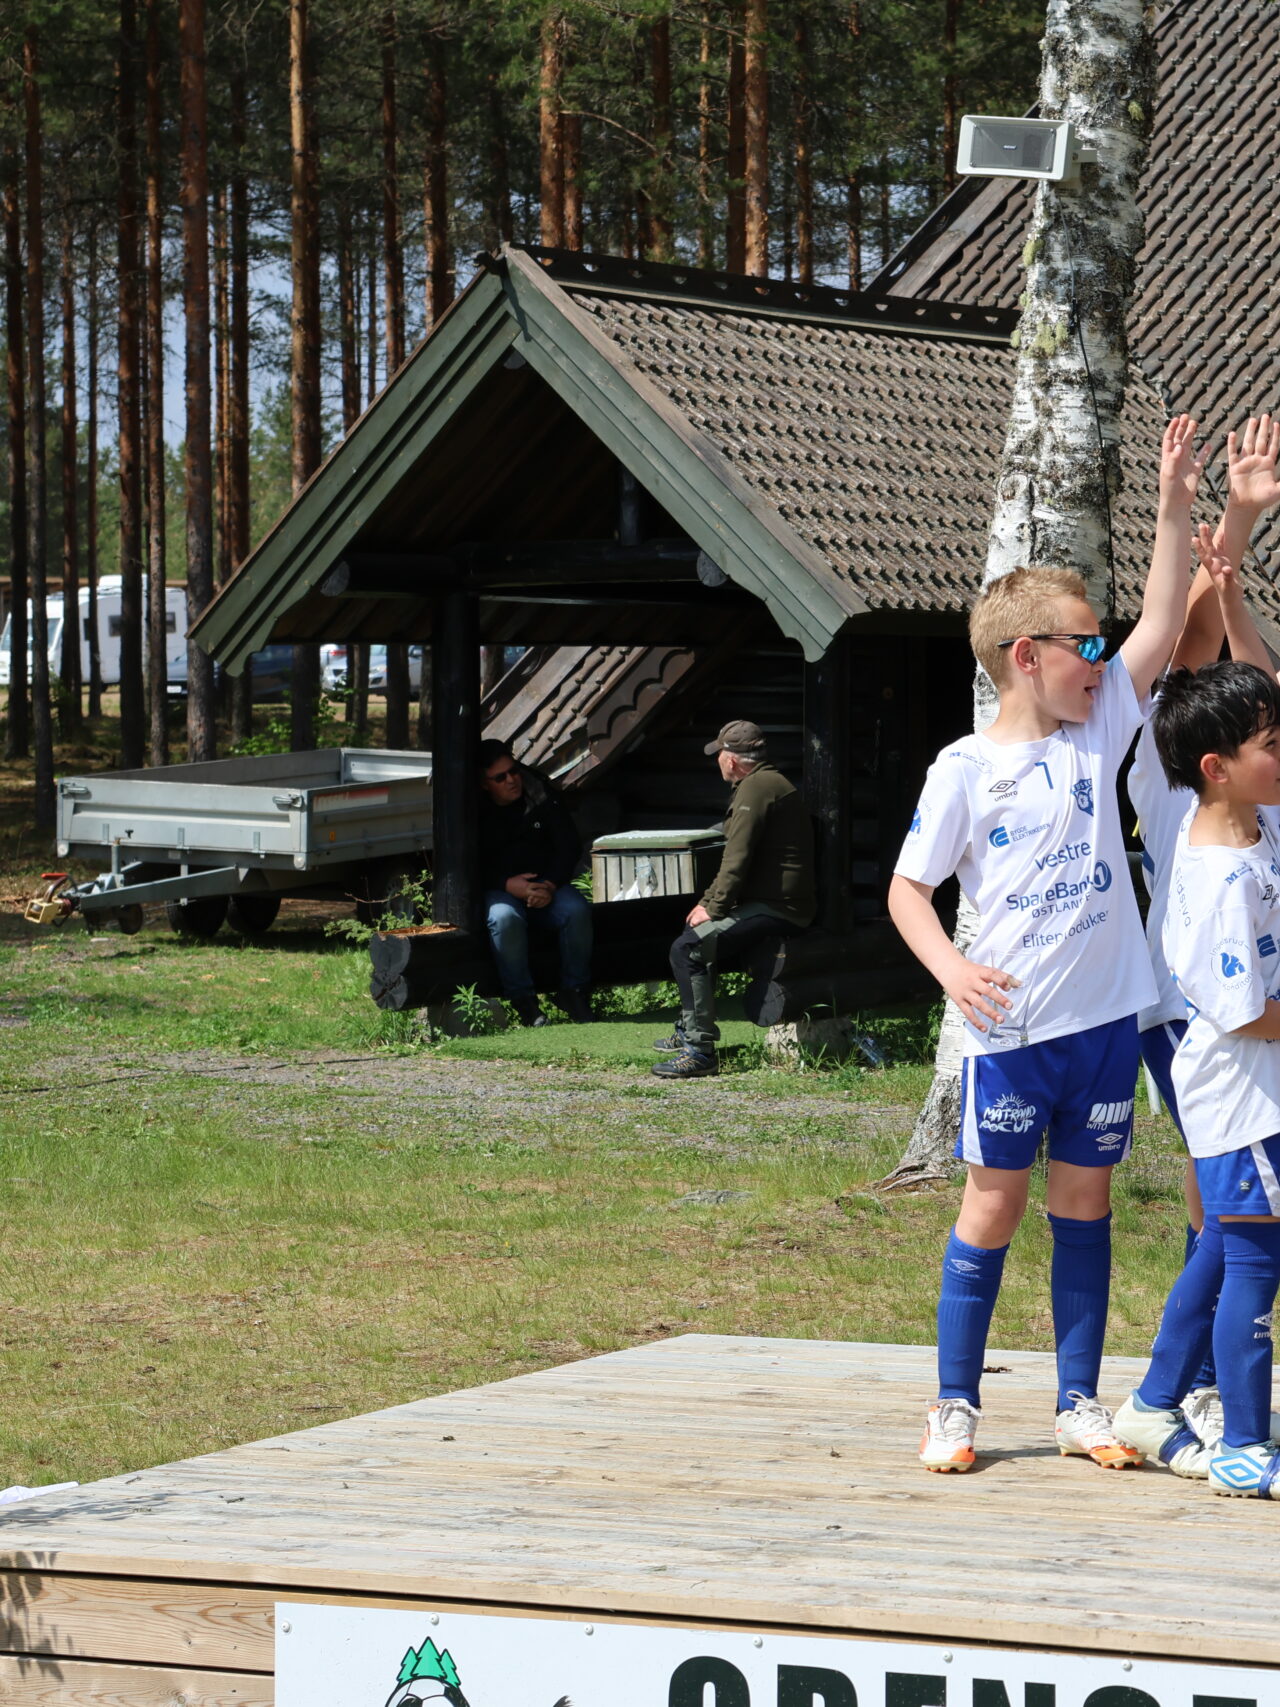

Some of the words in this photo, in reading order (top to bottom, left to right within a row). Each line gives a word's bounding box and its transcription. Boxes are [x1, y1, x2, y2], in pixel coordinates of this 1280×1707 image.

[994, 790, 1018, 802] umbro
[1034, 841, 1092, 871] vestre
[983, 1104, 1037, 1122] MATRAND
[1098, 1143, 1121, 1152] umbro
